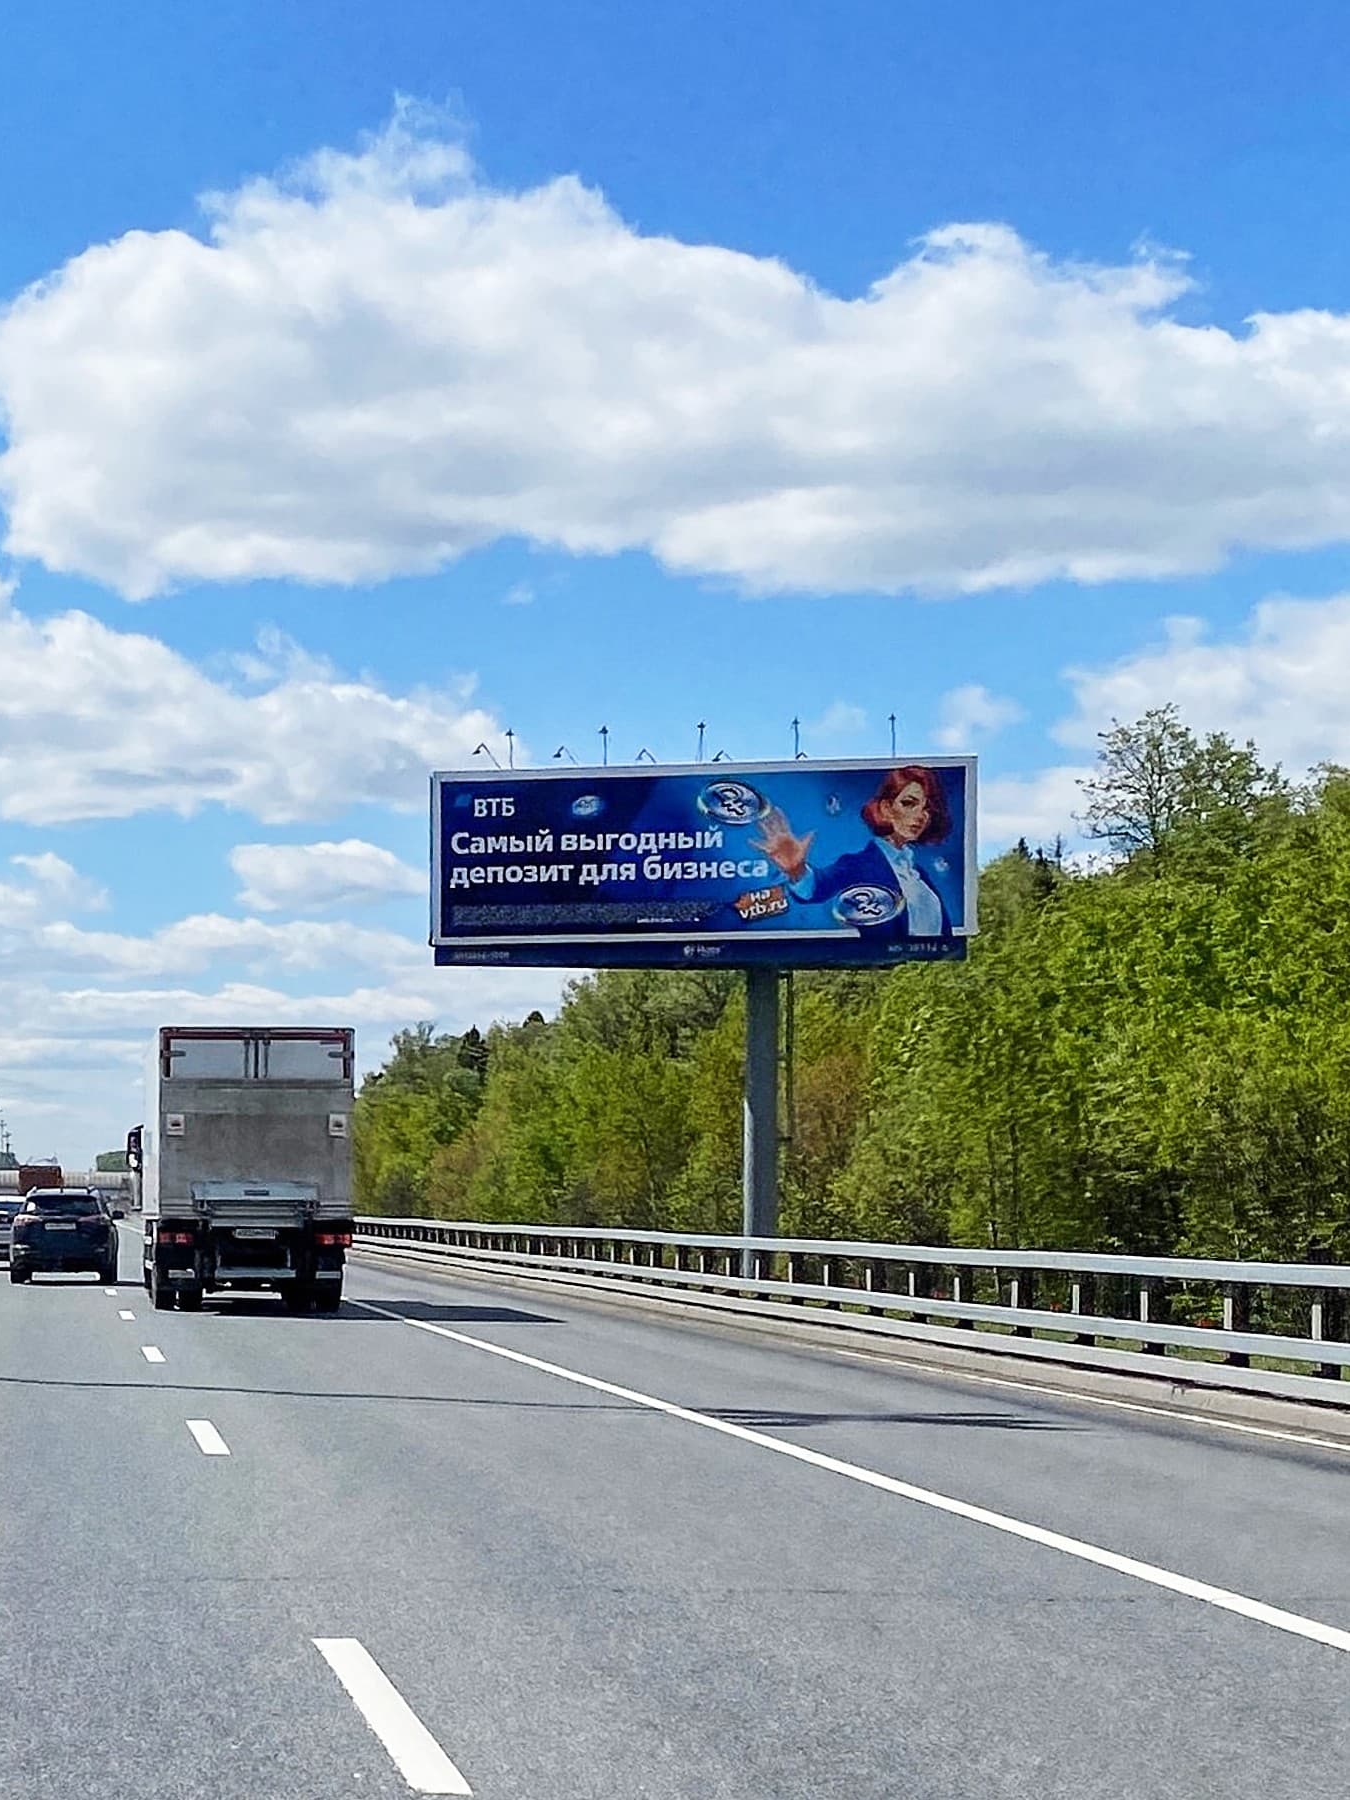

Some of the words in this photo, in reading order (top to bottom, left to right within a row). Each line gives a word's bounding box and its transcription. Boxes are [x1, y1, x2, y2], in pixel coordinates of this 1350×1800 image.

[473, 797, 515, 817] ВТБ
[451, 828, 554, 855] Самый
[560, 826, 724, 854] выгодный
[450, 863, 575, 889] депозит
[578, 861, 637, 886] для
[643, 855, 770, 880] бизнеса
[750, 889, 771, 902] на
[739, 898, 788, 919] vtb.ru
